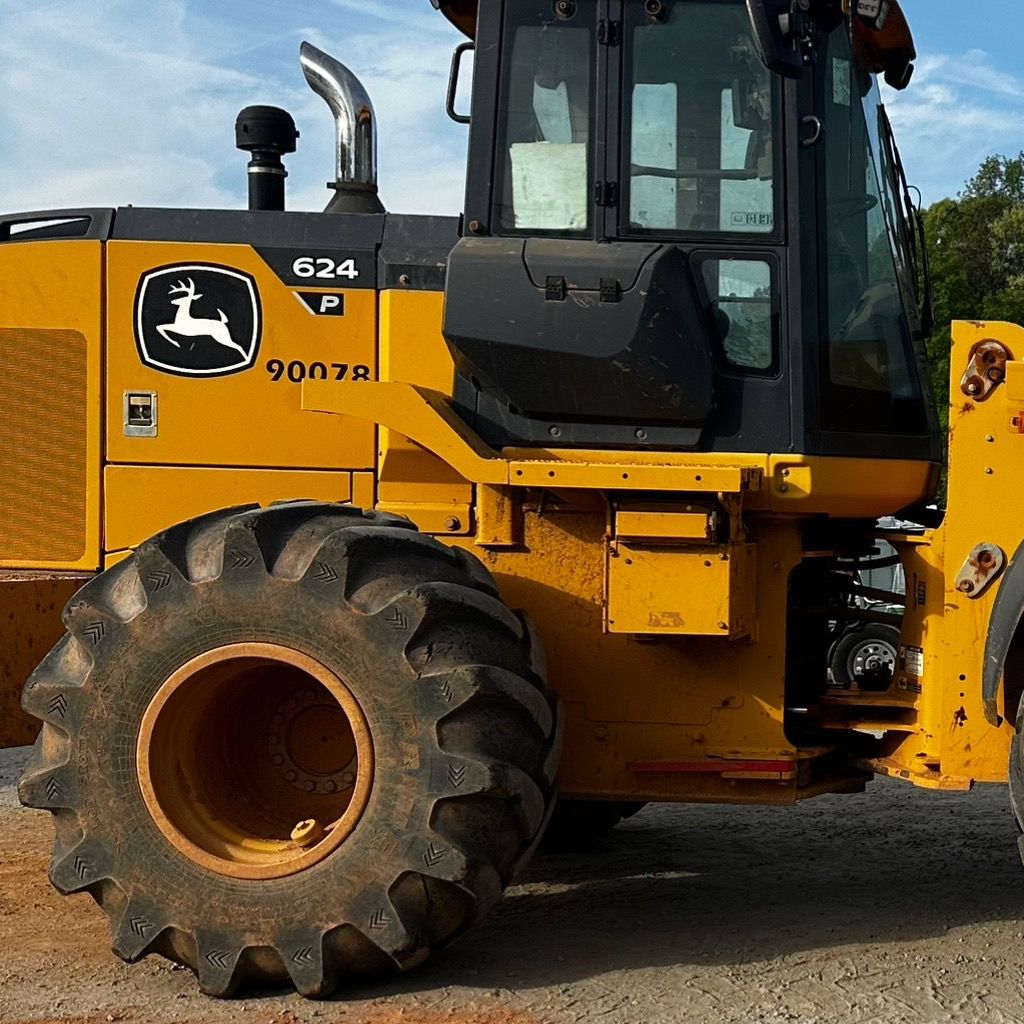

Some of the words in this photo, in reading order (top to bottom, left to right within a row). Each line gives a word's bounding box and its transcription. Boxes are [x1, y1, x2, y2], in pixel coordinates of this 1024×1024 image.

[292, 256, 359, 280] 624
[319, 295, 340, 313] P
[265, 358, 370, 383] 90078
